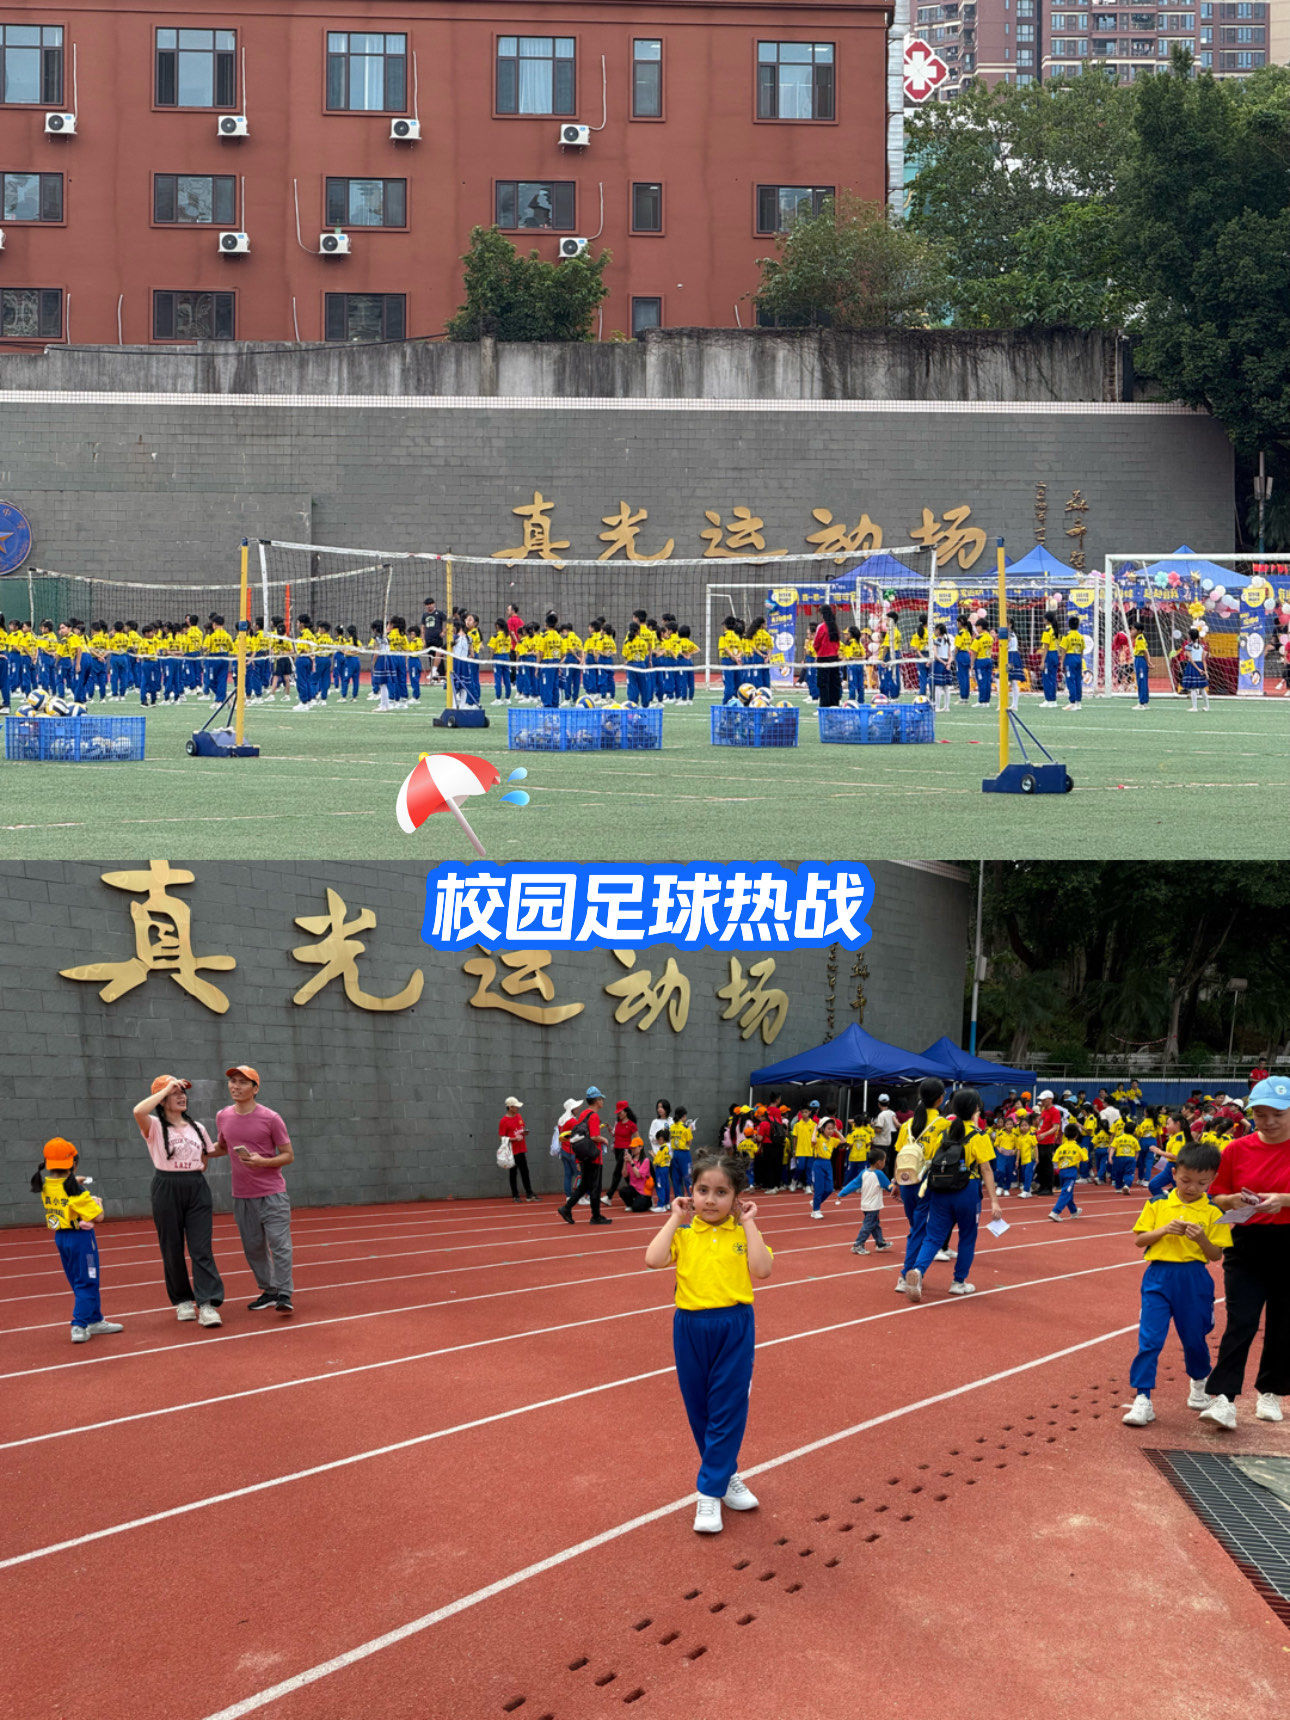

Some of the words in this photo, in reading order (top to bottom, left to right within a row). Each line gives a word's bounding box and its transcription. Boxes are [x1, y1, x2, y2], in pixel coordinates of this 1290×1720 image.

[490, 490, 987, 570] 真光运动场
